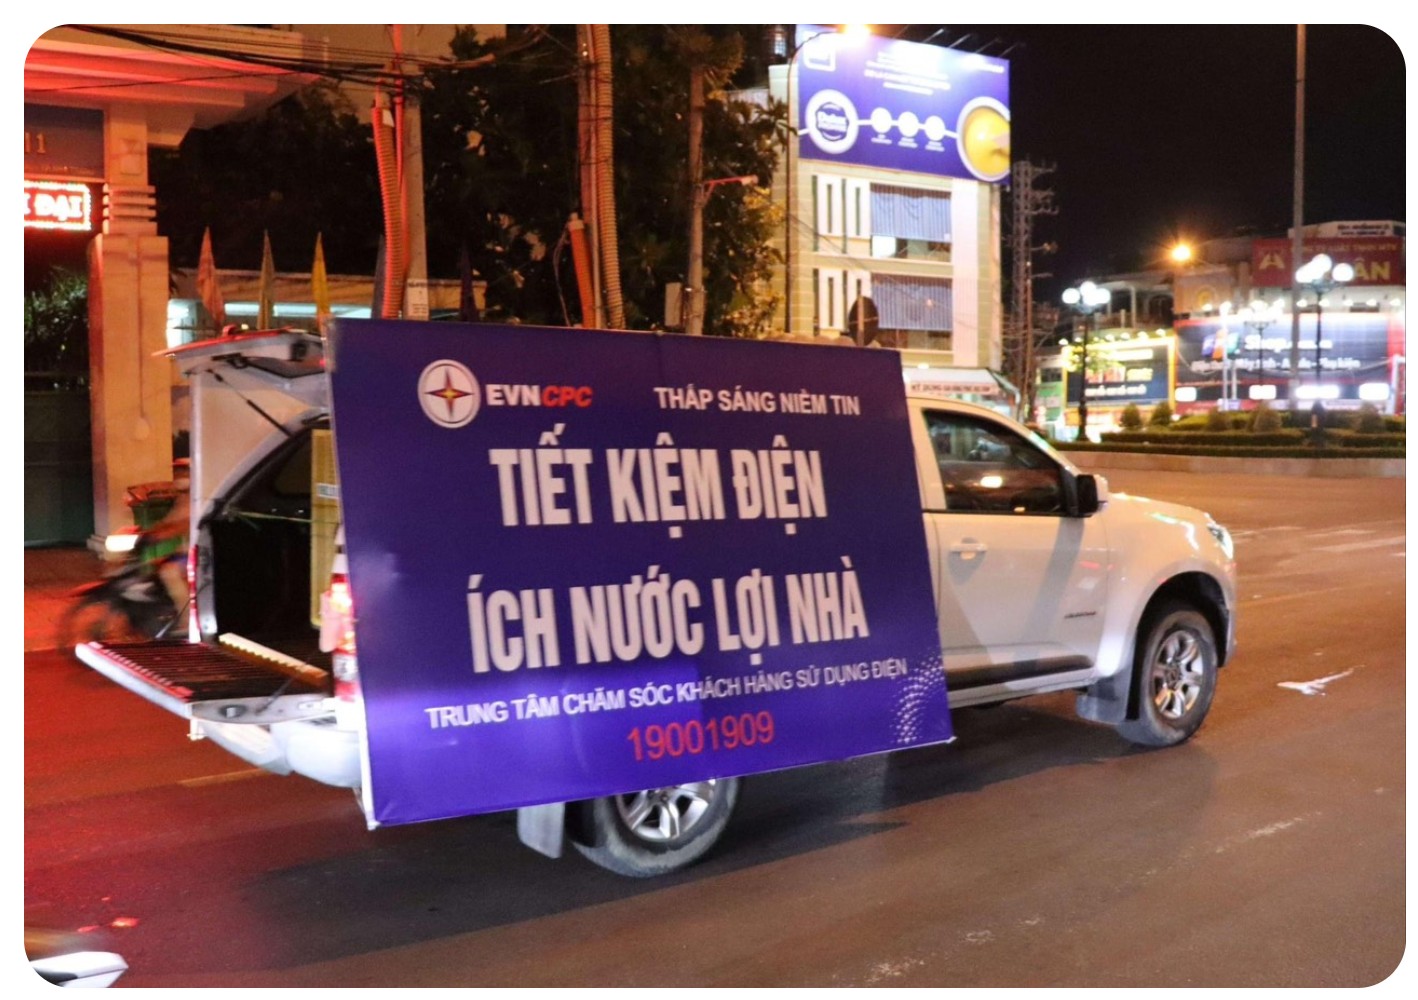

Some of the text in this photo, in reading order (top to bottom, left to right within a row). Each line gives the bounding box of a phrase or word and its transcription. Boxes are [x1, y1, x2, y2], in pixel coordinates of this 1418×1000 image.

[485, 383, 593, 408] EVNCPC
[717, 385, 776, 412] SÁNG
[829, 394, 861, 416] TIN
[488, 422, 828, 539] TIẾT KIỆM ĐIỆN
[466, 554, 870, 674] ÍCH NƯỚC LỢI NHÀ
[424, 657, 908, 729] TRUNG TÂM CHĂM SÓC KHÁCH HÀNG SỬ DỤNG ĐIỆN
[627, 710, 774, 761] 19001909
